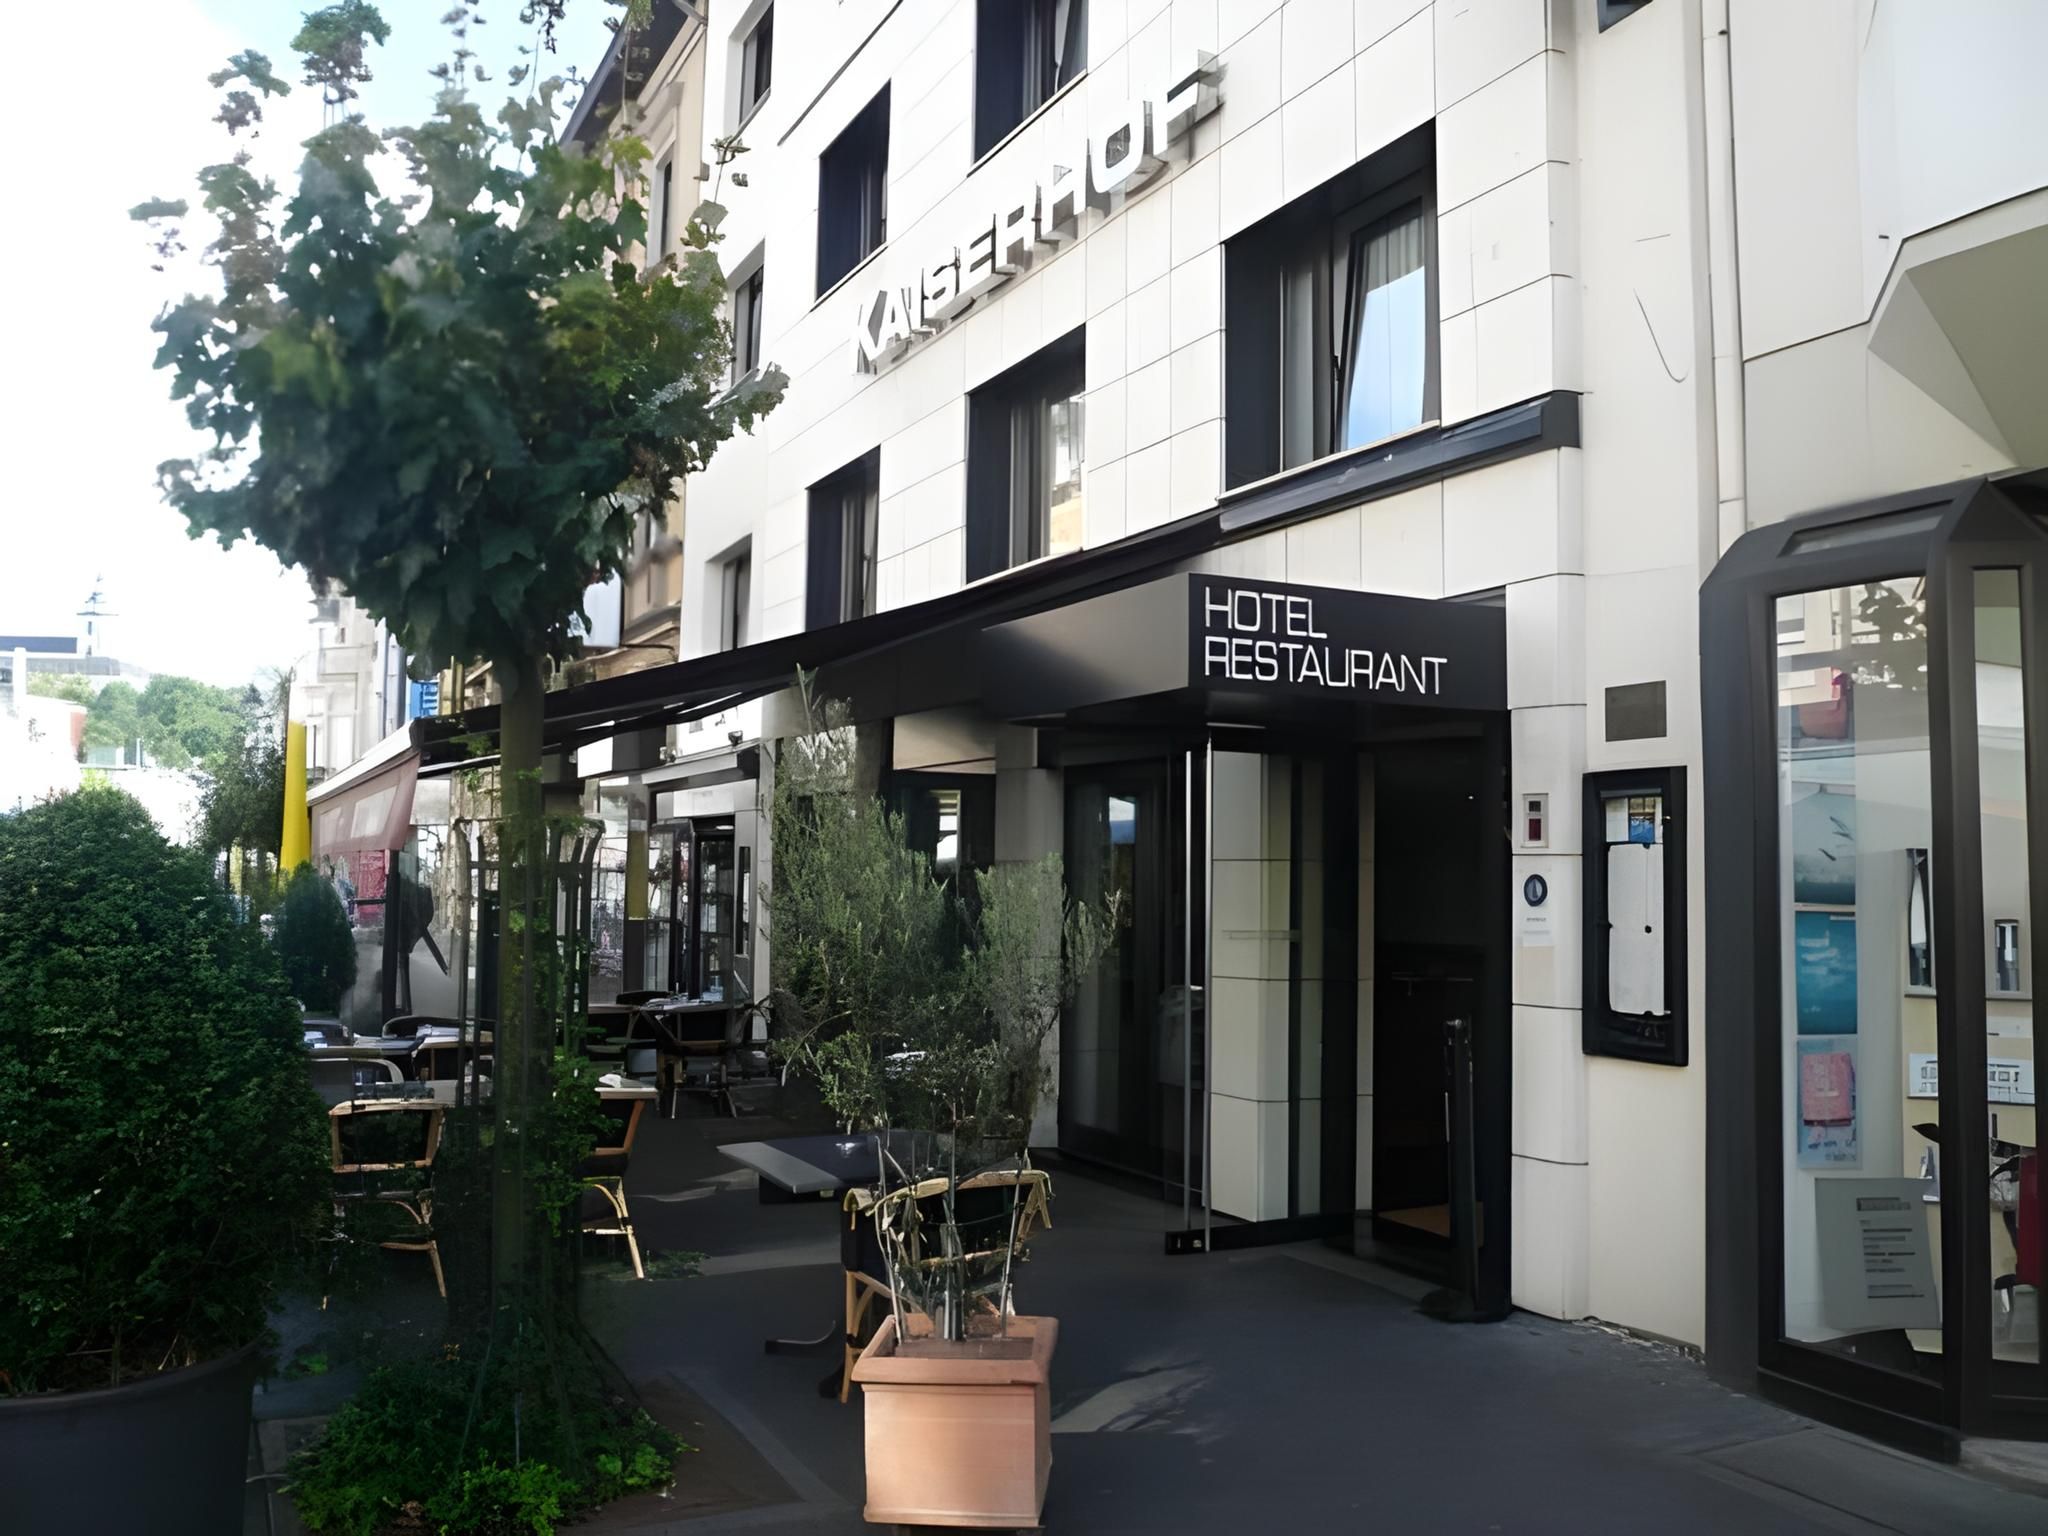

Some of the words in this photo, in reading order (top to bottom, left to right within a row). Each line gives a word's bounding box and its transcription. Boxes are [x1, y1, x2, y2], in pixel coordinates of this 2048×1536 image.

[854, 50, 1224, 374] KAISERHOF
[1204, 586, 1328, 639] HOTEL
[1204, 635, 1448, 695] RESTAURANT
